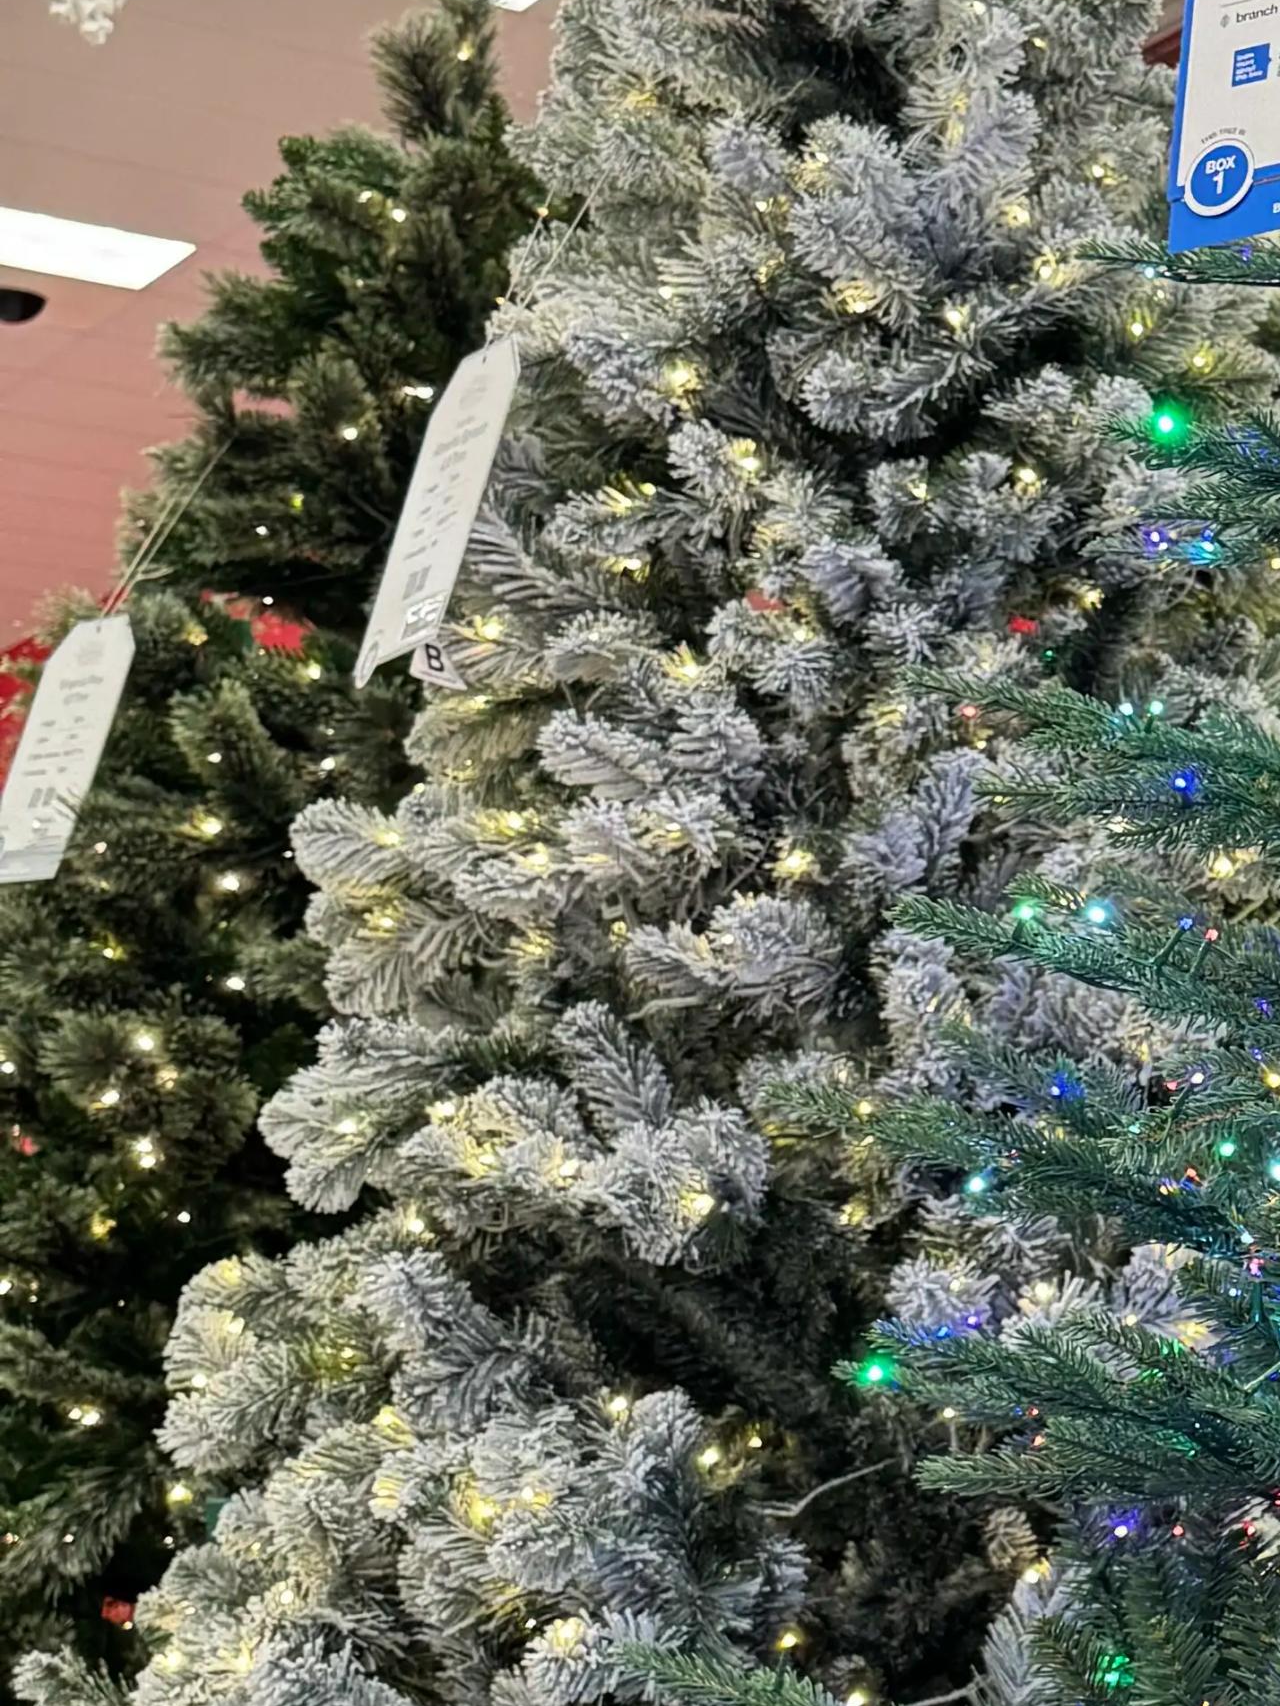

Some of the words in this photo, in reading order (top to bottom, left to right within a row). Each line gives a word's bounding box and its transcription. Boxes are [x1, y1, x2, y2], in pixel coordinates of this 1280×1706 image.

[1236, 4, 1279, 24] branch
[1205, 155, 1236, 174] BOX
[1212, 171, 1225, 195] 1
[425, 643, 444, 672] B
